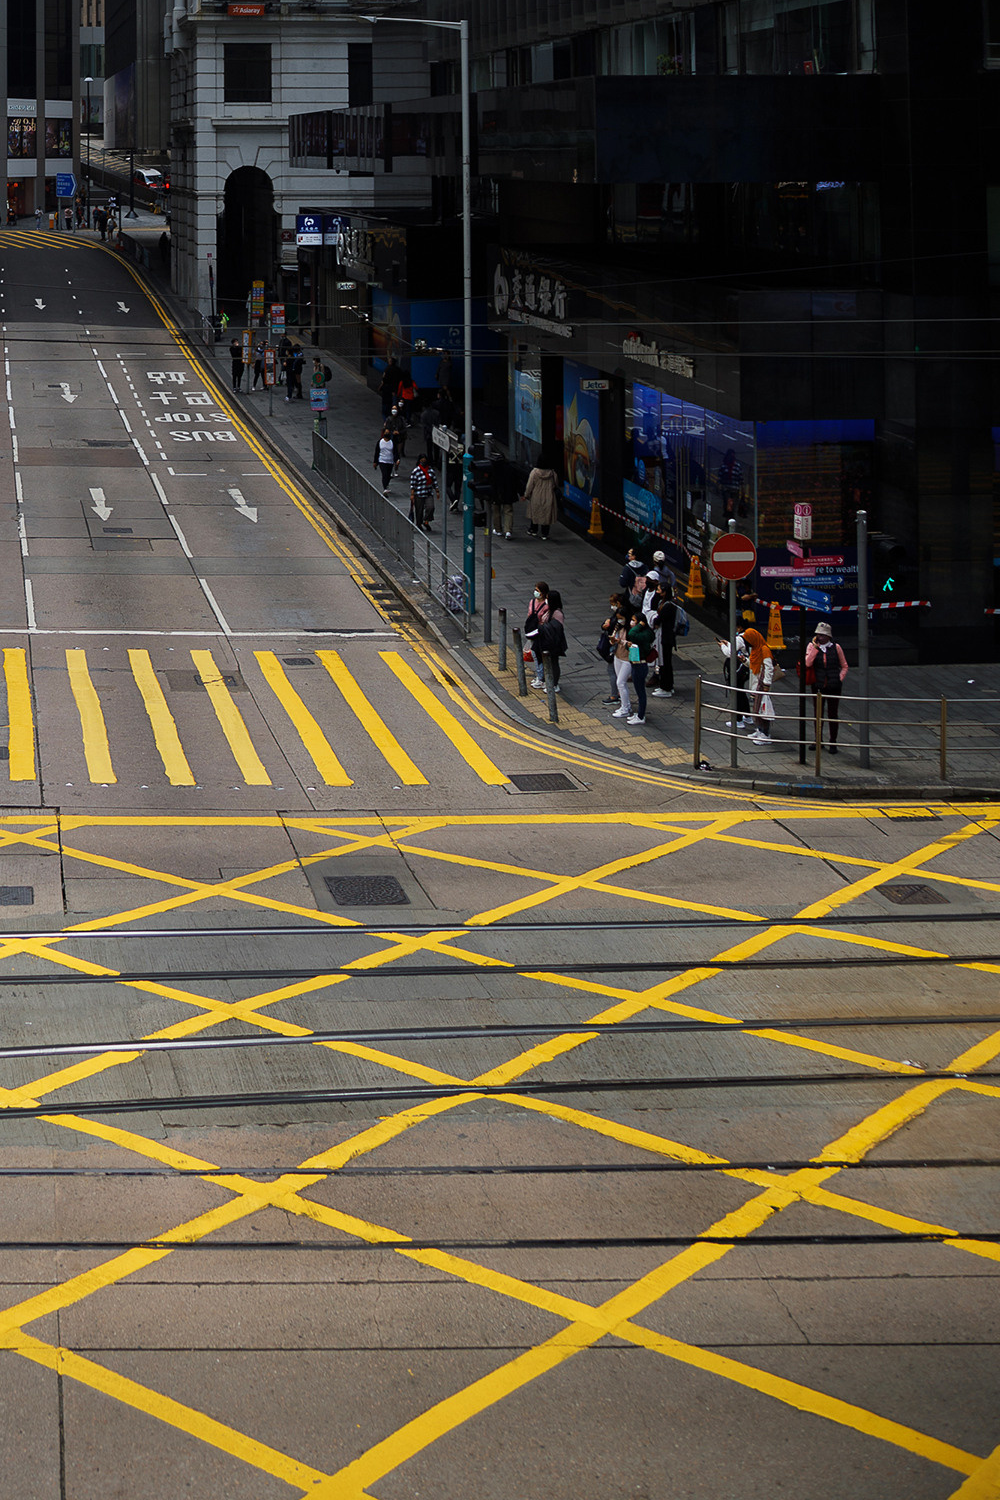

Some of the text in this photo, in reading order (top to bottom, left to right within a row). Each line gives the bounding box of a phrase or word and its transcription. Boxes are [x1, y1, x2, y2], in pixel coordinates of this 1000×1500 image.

[239, 6, 261, 16] Asiaray
[146, 371, 190, 385] 站
[585, 381, 607, 389] Jetco
[149, 391, 214, 406] 巴士
[154, 412, 232, 423] STOP
[169, 430, 238, 442] BUS
[826, 566, 834, 574] to
[838, 581, 859, 590] Clien
